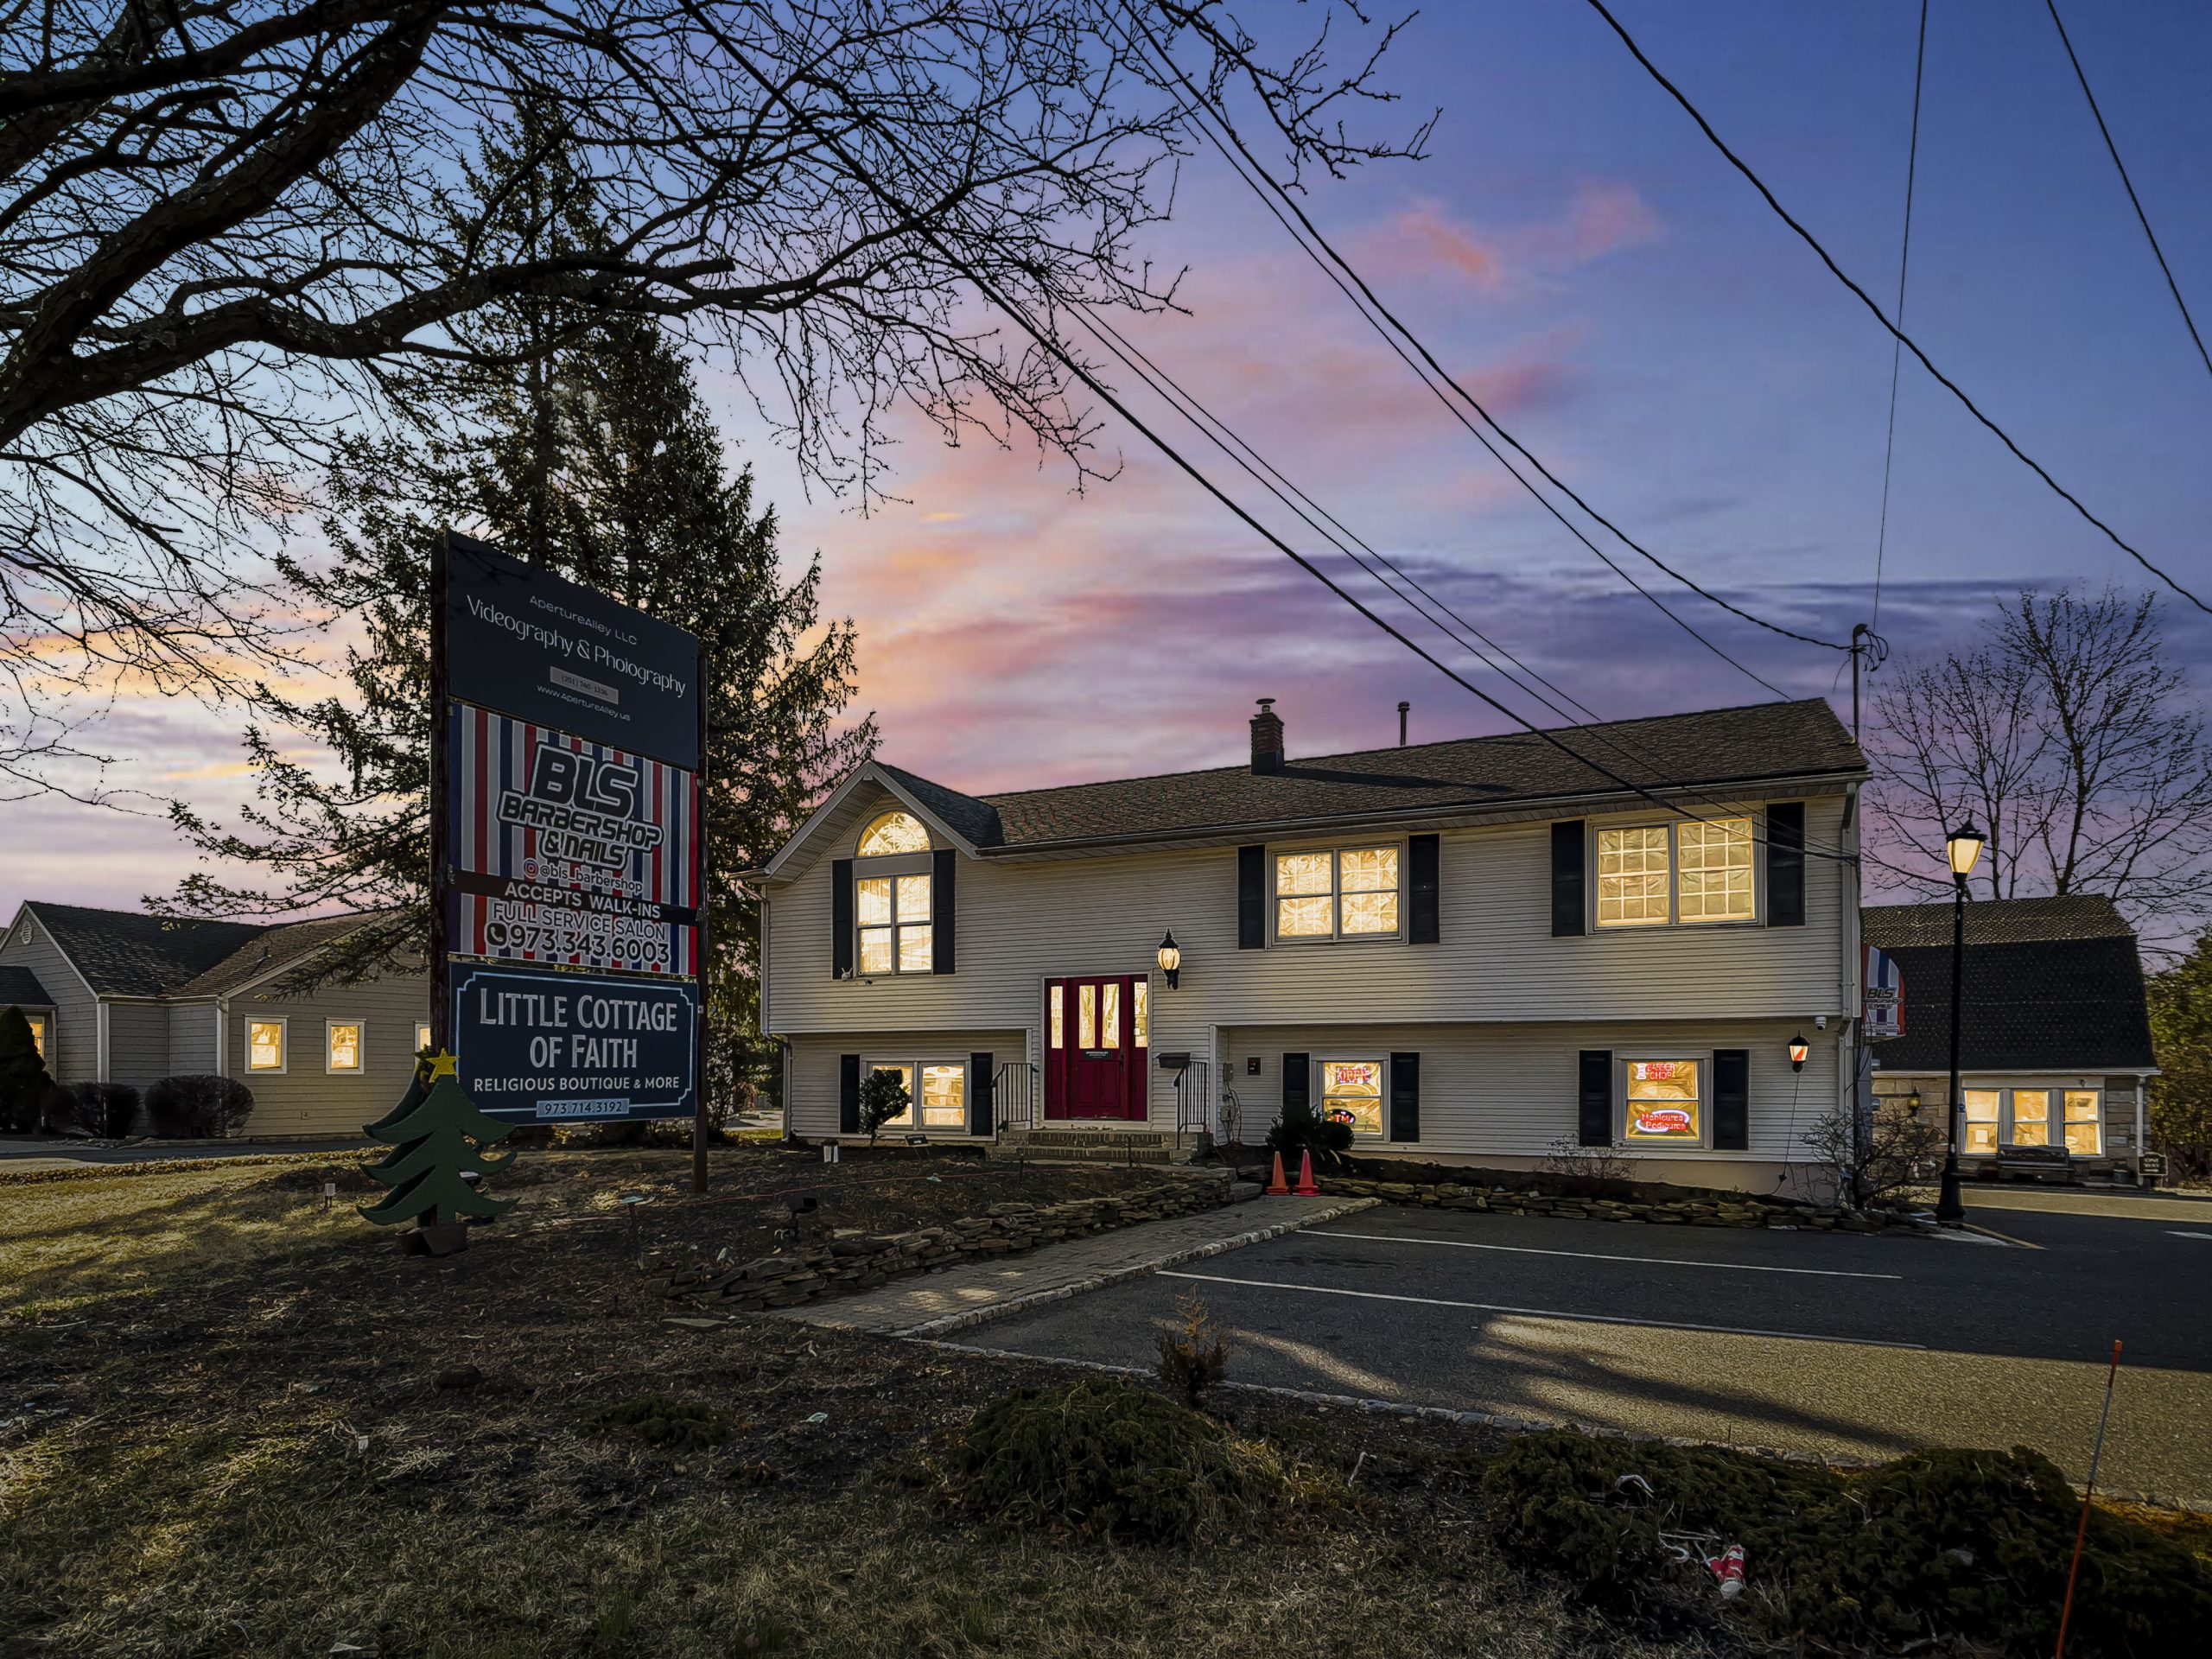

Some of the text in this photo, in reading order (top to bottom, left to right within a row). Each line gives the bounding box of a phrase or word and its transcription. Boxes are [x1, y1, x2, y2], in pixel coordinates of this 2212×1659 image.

[467, 594, 573, 657] Videography
[577, 639, 590, 660] &
[529, 595, 638, 645] ApertureAlley LLC
[531, 744, 638, 820] BLS
[500, 793, 662, 849] BARBERSHOP
[543, 830, 627, 867] & NAILS
[540, 866, 643, 894] @bls_barbershop
[505, 882, 661, 918] ACCEPTS WALK-INS
[493, 902, 665, 941] FULL SERVICE SALON
[510, 925, 671, 964] 973.343.6003
[480, 988, 677, 1032] LITTLE COTTAGE
[1866, 988, 1895, 998] BLS
[530, 1034, 638, 1069] OF FAITH
[474, 1077, 679, 1092] RELIGIOUS BOUTIQUE & MORE
[1339, 1070, 1369, 1081] OPEN
[544, 1101, 623, 1116] 973.714.3192
